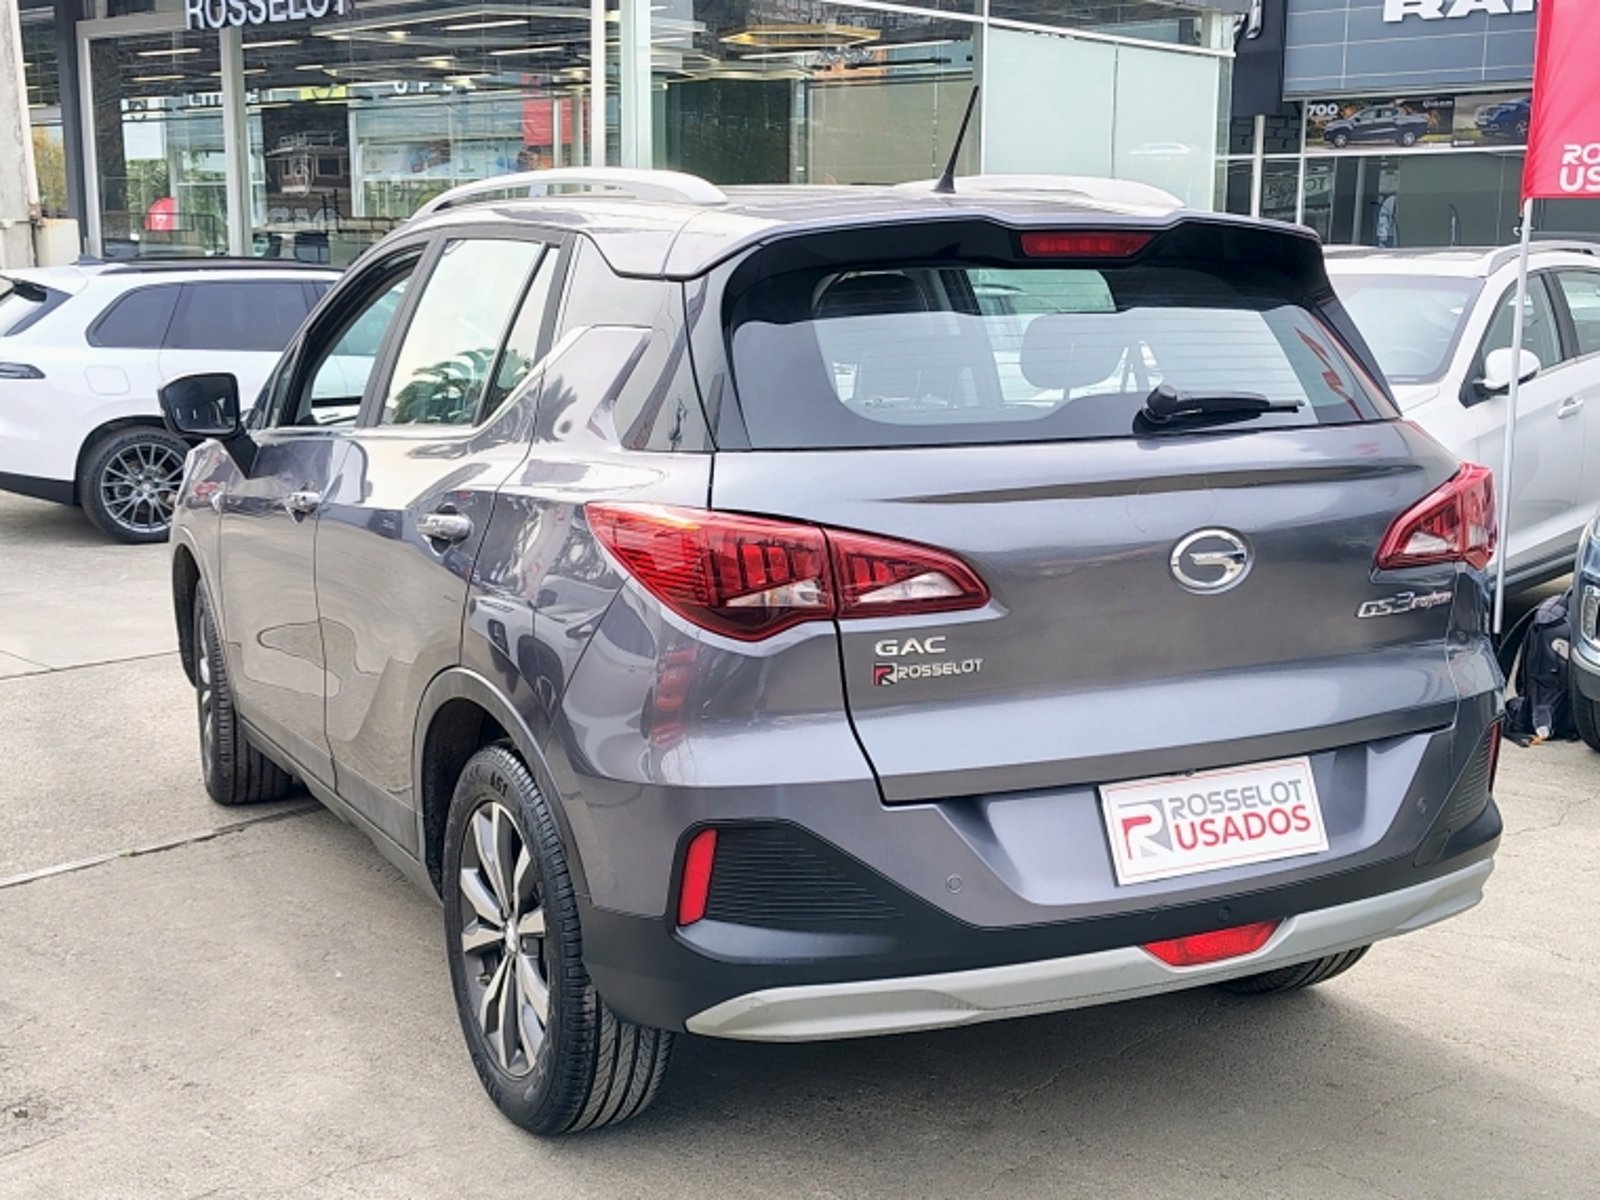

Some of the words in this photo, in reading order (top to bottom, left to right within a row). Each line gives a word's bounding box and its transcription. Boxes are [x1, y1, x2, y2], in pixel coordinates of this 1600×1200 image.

[1383, 0, 1534, 22] RA
[875, 635, 946, 656] GAC
[1168, 779, 1302, 820] ROSSELOT
[1173, 804, 1311, 851] USADOS
